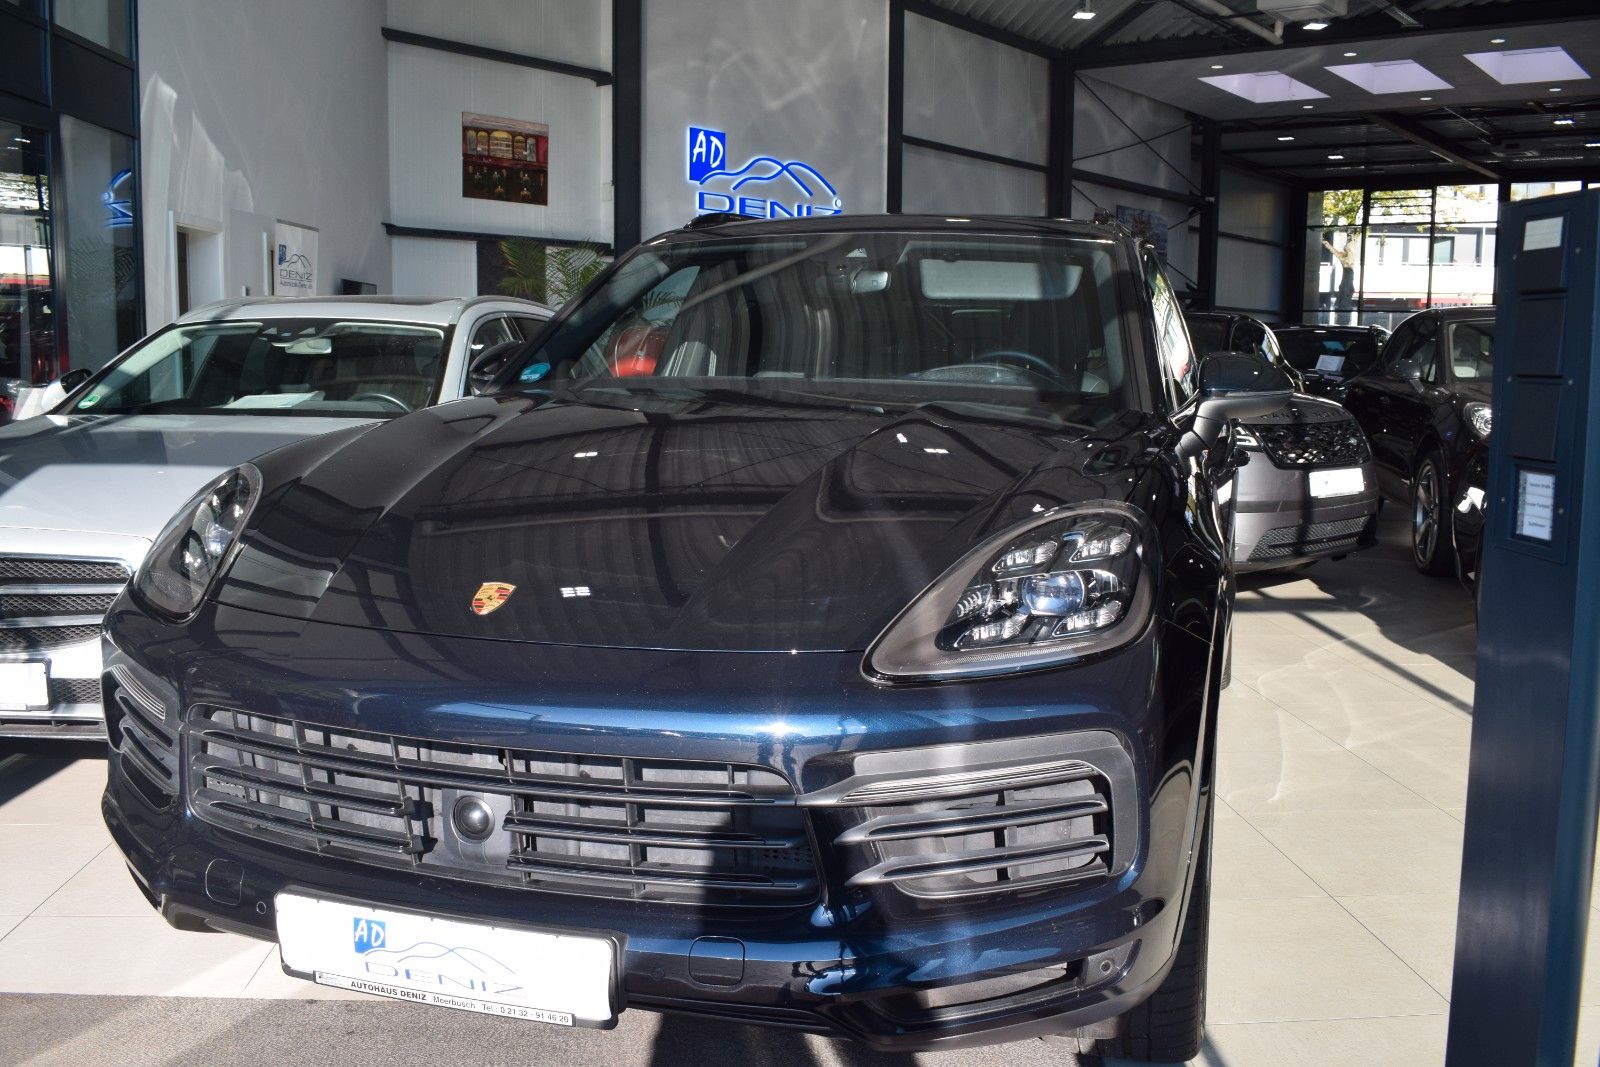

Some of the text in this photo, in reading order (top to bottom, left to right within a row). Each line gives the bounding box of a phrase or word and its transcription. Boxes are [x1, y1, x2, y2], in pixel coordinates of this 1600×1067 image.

[692, 131, 724, 168] AD
[279, 269, 313, 280] DENIZ
[354, 919, 385, 947] AD
[365, 961, 527, 999] DENIZ
[350, 981, 398, 996] AUTOHAUS
[400, 990, 427, 1001] DENIZ
[433, 996, 476, 1009] Meerbusch
